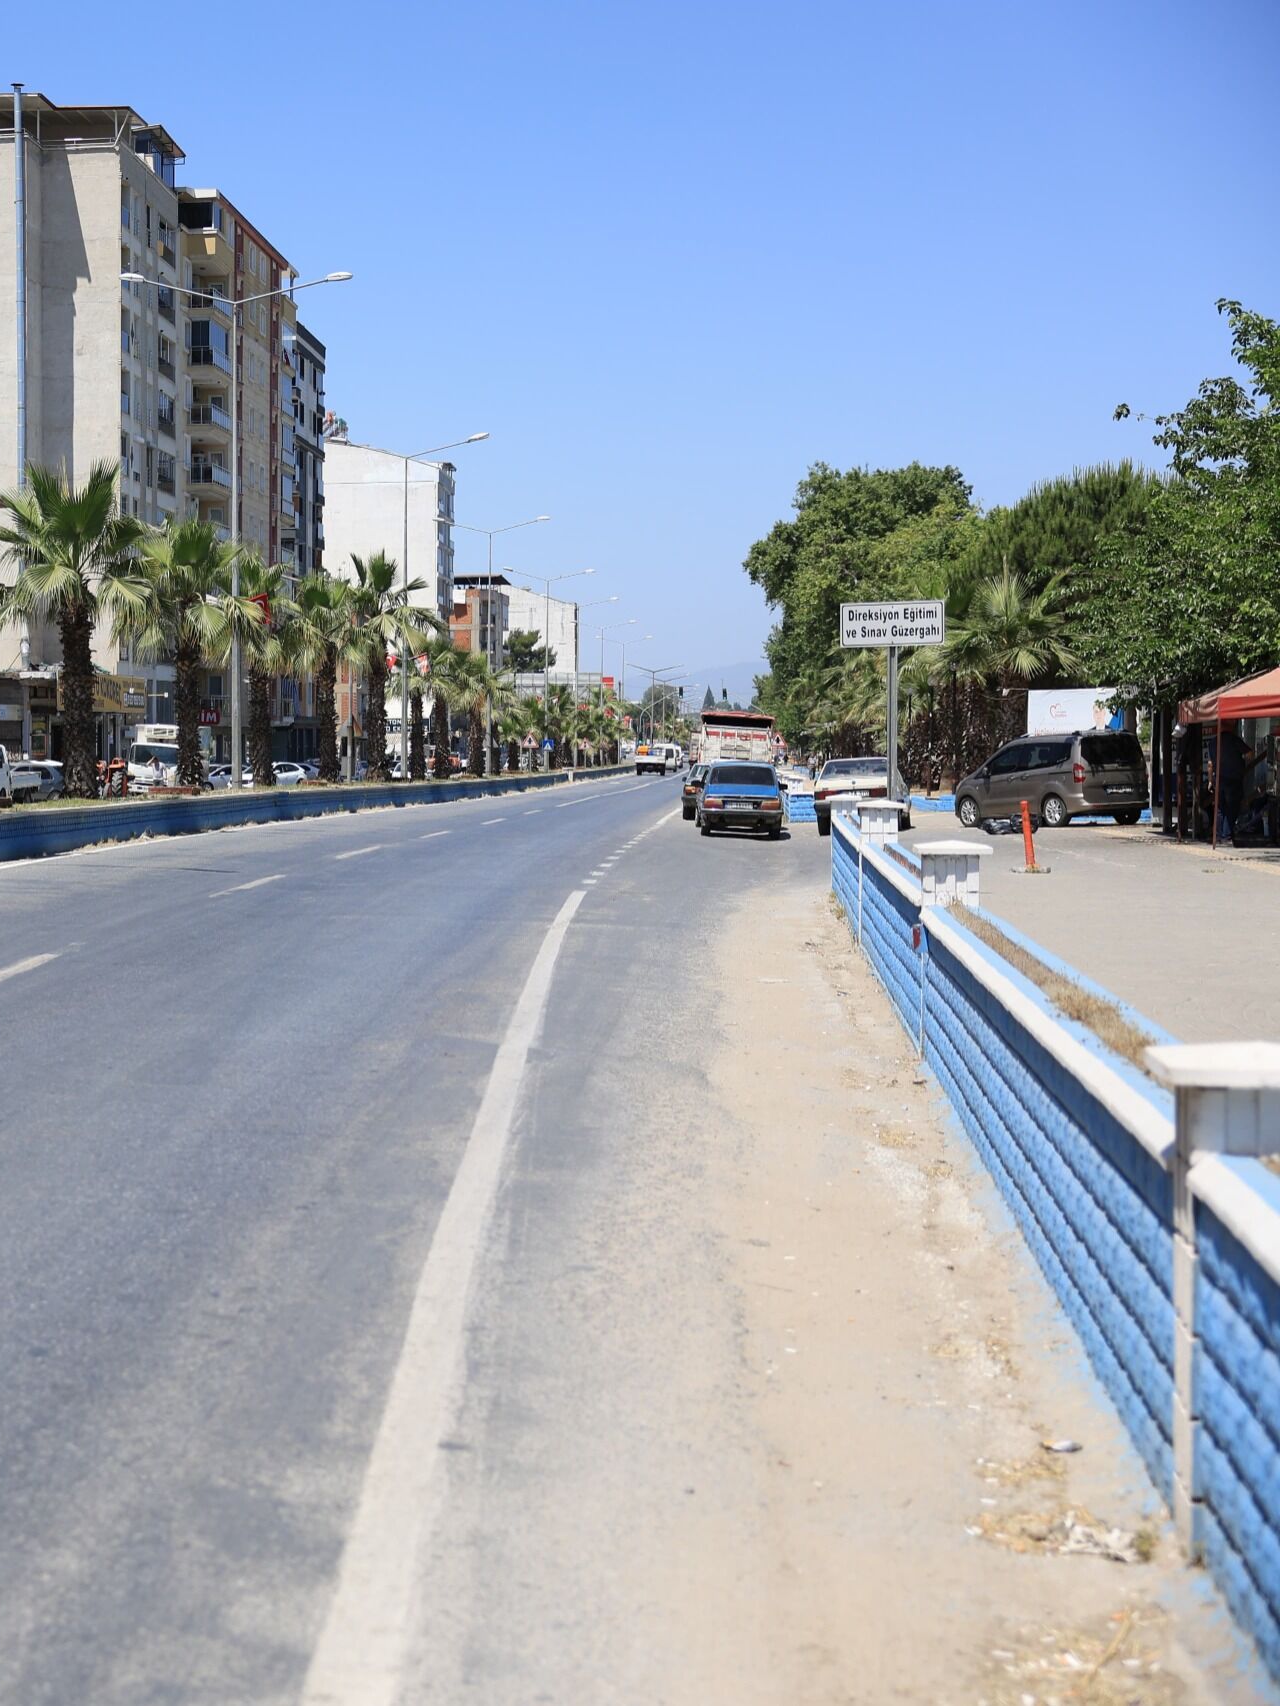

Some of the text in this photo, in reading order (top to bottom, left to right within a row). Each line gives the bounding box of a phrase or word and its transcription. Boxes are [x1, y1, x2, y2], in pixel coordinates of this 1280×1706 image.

[848, 606, 938, 623] Direksiyon Eğitimi
[846, 624, 940, 639] ve Sınav Güzergahı
[201, 709, 217, 722] İM
